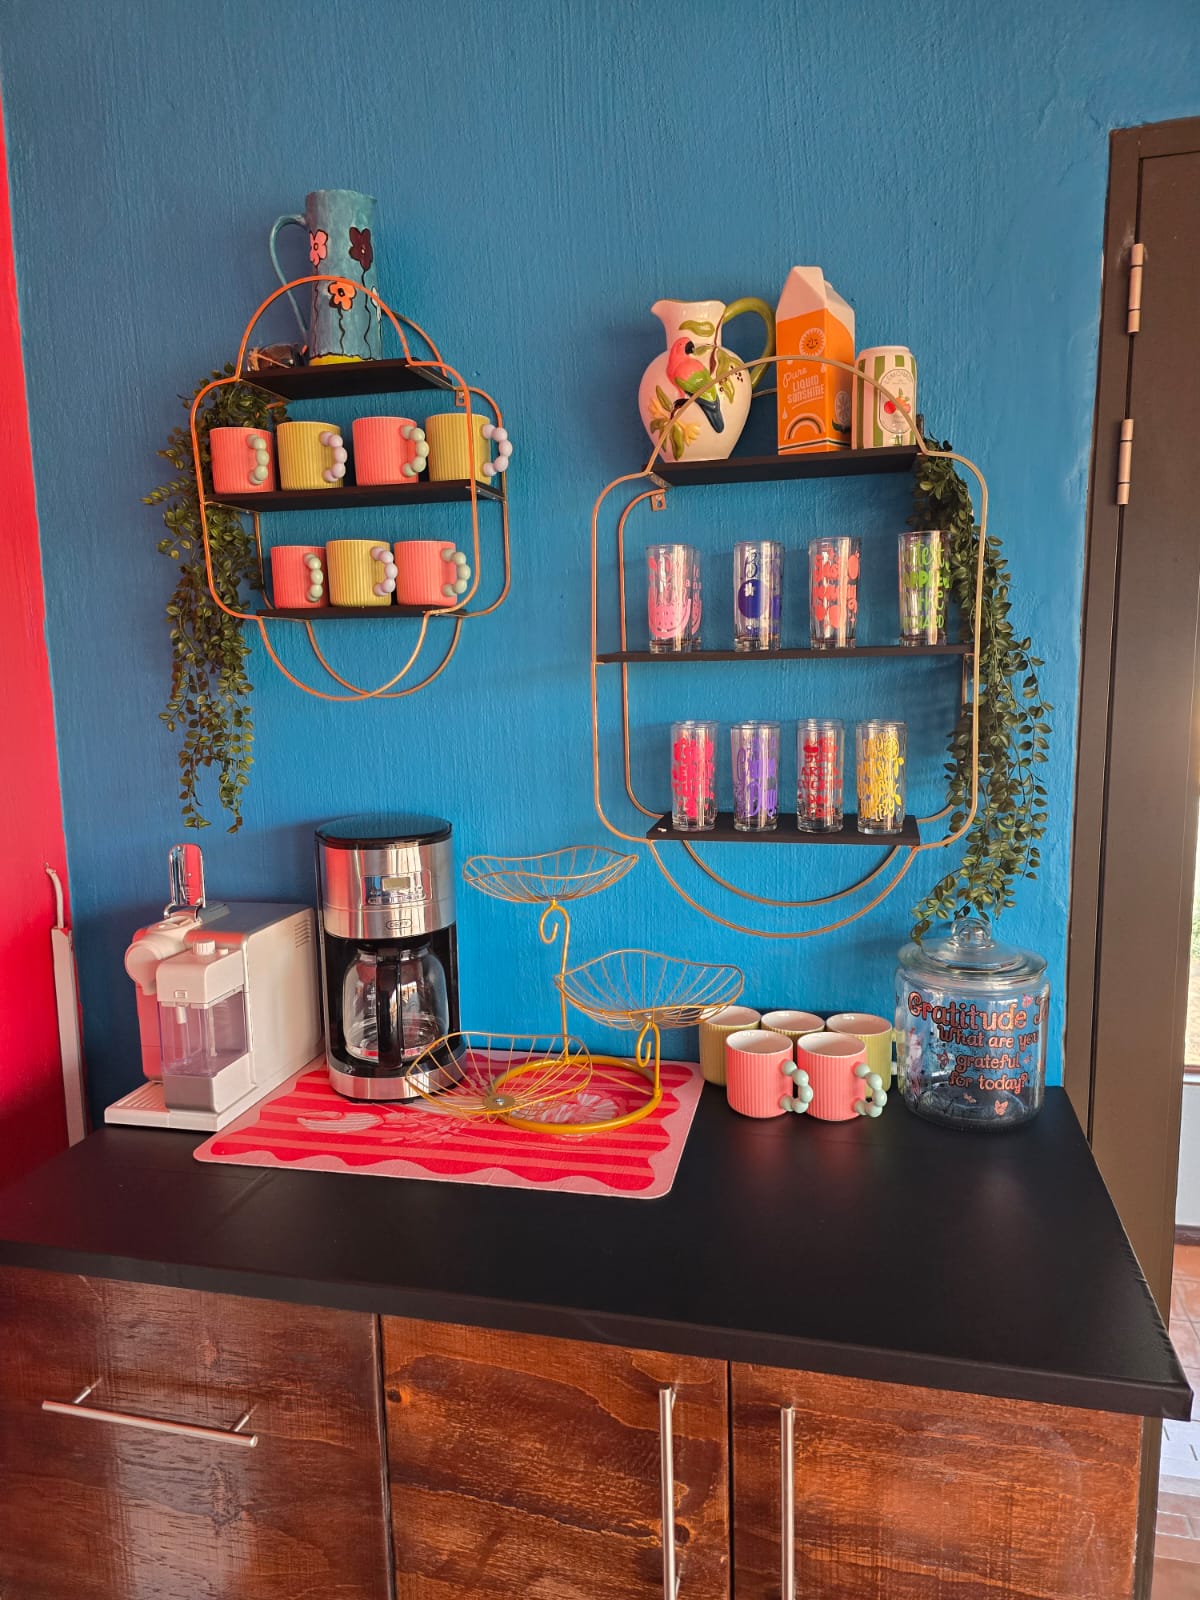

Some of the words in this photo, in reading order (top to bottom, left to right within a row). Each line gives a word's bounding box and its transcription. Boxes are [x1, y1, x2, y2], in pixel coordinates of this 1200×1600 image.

[908, 991, 1027, 1032] Gratitude
[937, 1024, 985, 1048] What
[988, 1034, 1014, 1048] are
[955, 1053, 1020, 1074] grateful
[949, 1072, 973, 1088] for
[978, 1071, 1029, 1095] today?
